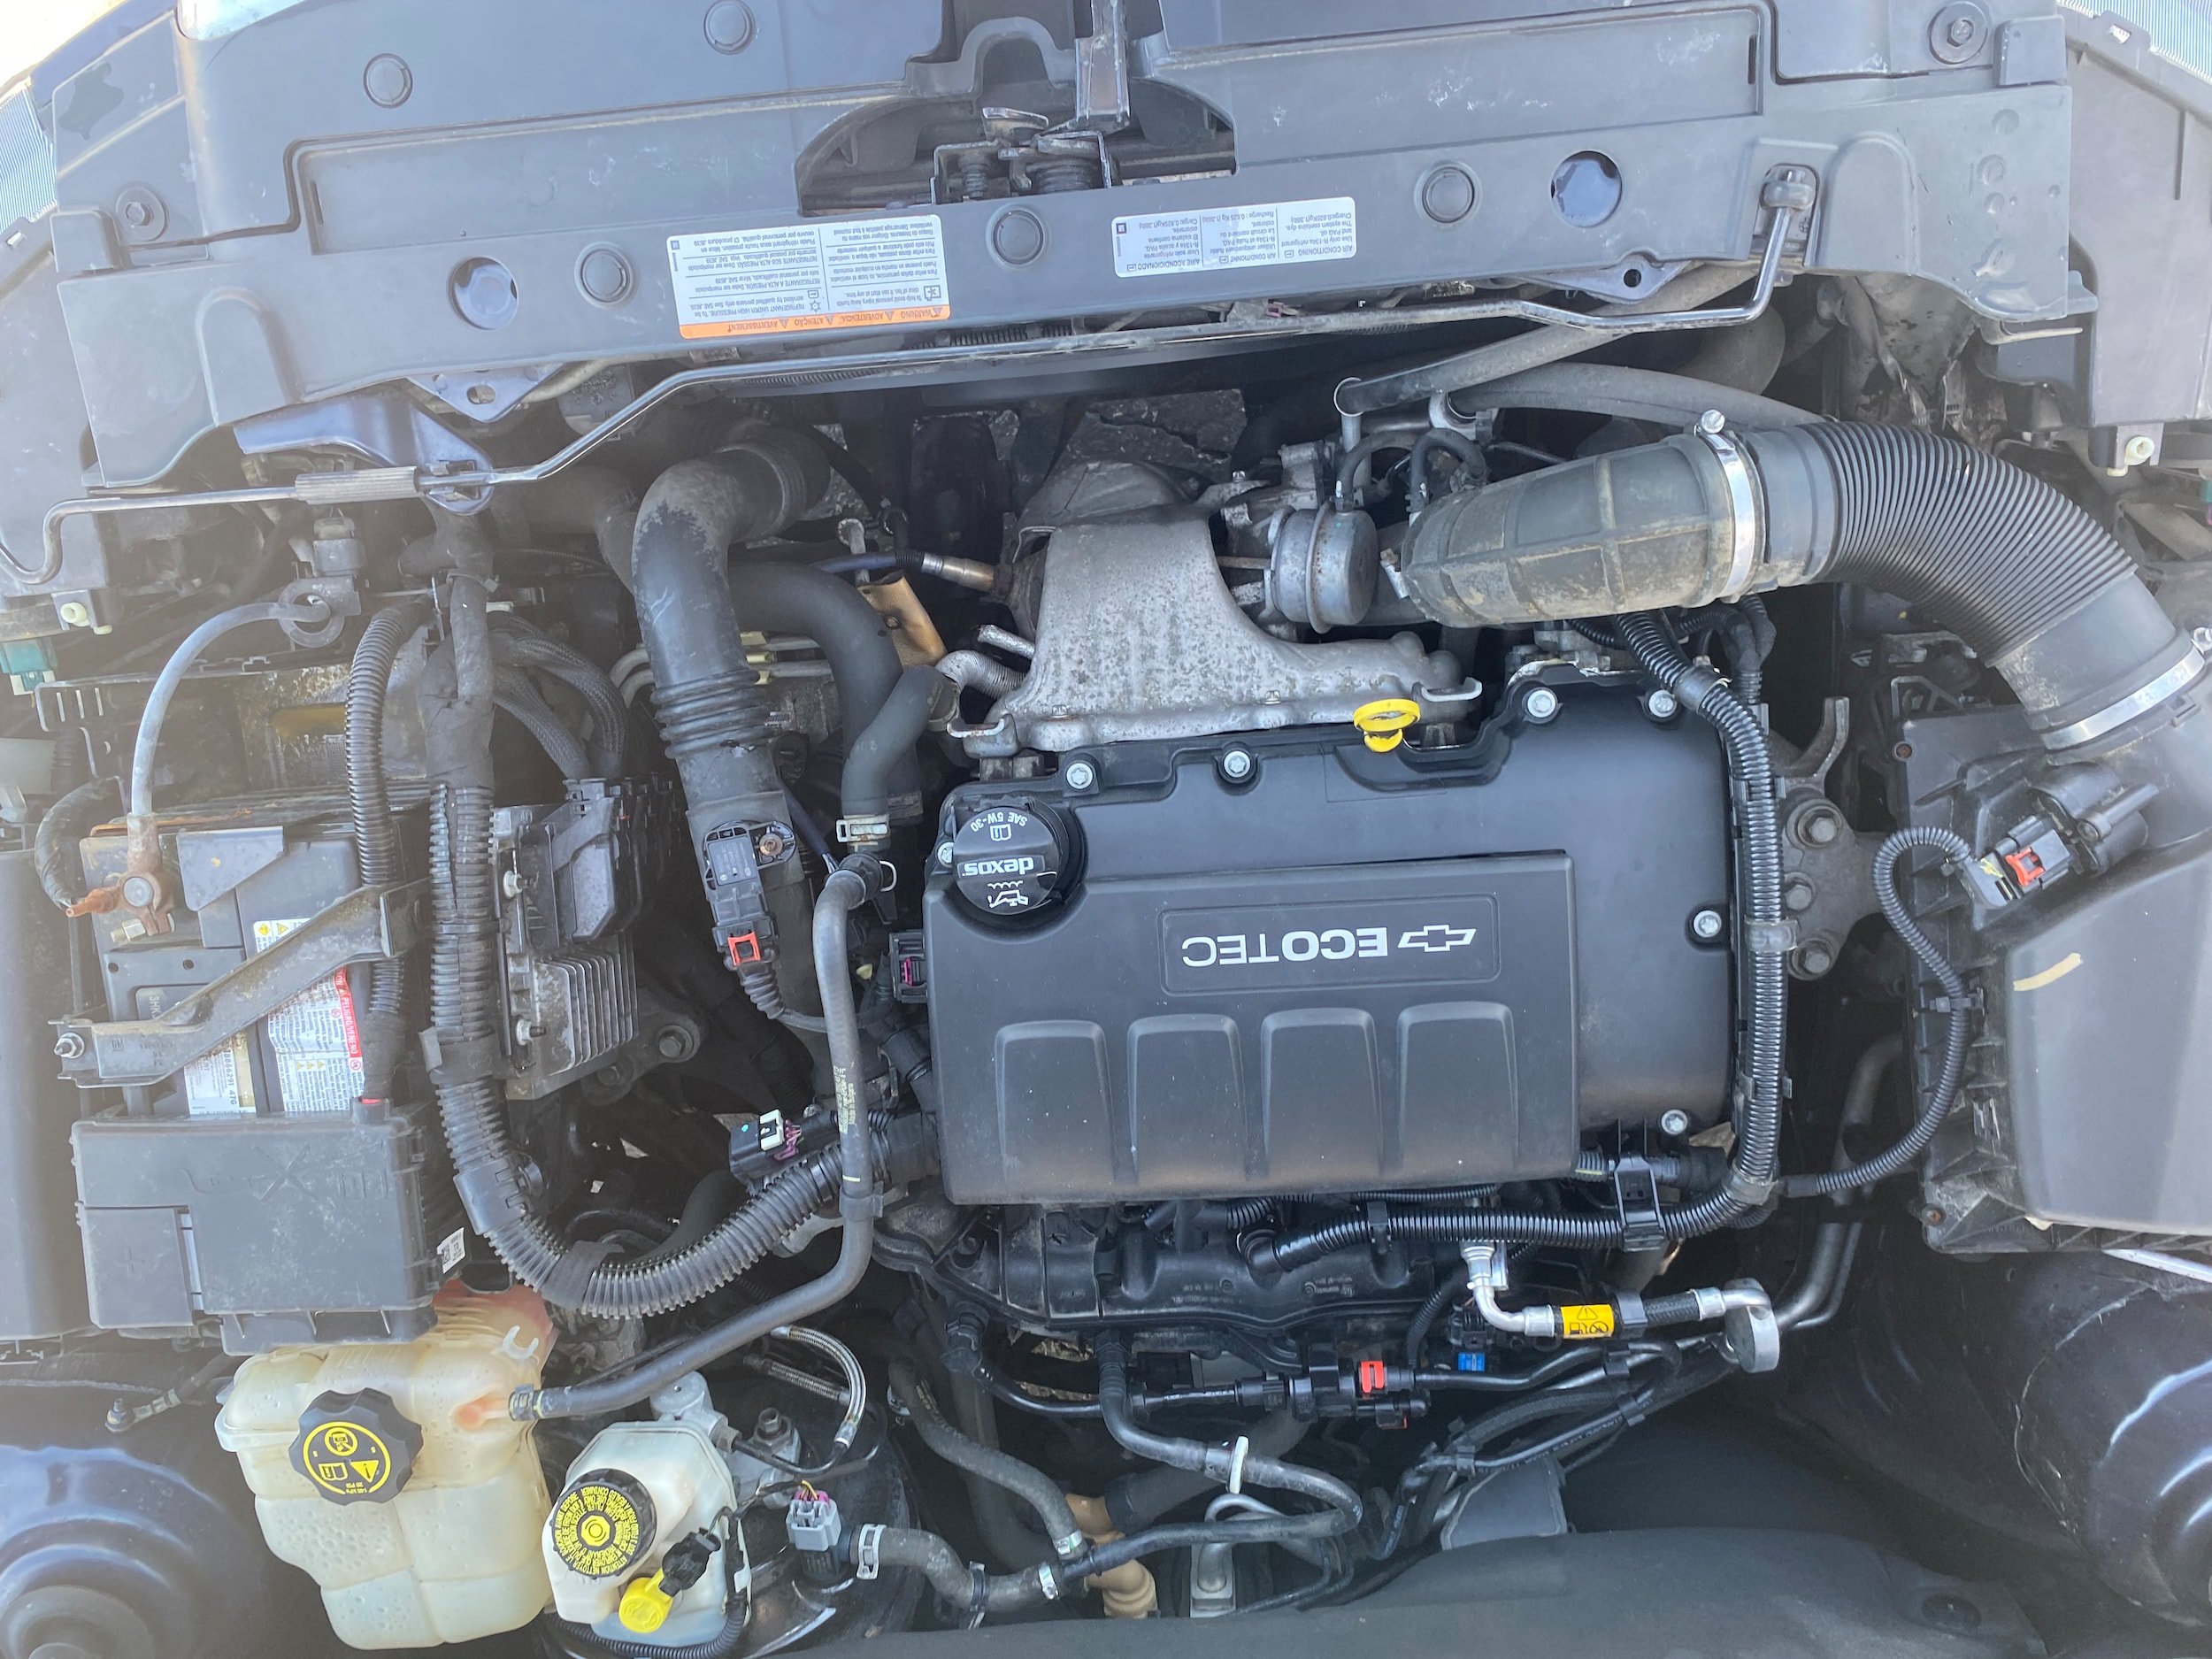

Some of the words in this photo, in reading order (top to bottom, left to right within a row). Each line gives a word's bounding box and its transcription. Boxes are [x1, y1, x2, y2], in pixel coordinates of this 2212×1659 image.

[1248, 210, 1273, 219] Recharge
[1225, 243, 1256, 252] uniquement
[1281, 238, 1308, 247] refrigerant
[1143, 250, 1173, 258] refrigerante
[1298, 245, 1340, 256] CONDITIONING
[1137, 259, 1185, 270] ACONDICIONADO
[770, 302, 804, 311] REFRIGERANT
[900, 308, 931, 319] WARNING
[727, 319, 778, 332] AVERTISSEMENT
[794, 316, 824, 326] ATENÇÃO
[970, 811, 1003, 832] 5W-30
[1008, 811, 1027, 827] SAE
[964, 856, 1033, 875] dexos
[1181, 926, 1388, 968] ECOTEC
[341, 996, 357, 1054] PELIGRO/VENENO
[580, 1486, 609, 1497] CONTAINER
[608, 1488, 629, 1507] SEALED
[582, 1494, 595, 1504] ONLY
[596, 1494, 606, 1503] USE
[569, 1501, 580, 1513] DOT
[585, 1502, 604, 1511] FILLER
[603, 1504, 620, 1521] CLEAN
[562, 1509, 574, 1526] FREIN
[626, 1506, 639, 1523] FROM
[561, 1526, 569, 1535] DE
[630, 1522, 640, 1539] FLUID
[553, 1529, 568, 1557] BOUCHON
[562, 1534, 576, 1555] LIQUIDE
[572, 1540, 582, 1550] UN
[618, 1540, 629, 1552] CAP
[625, 1542, 637, 1556] DOT
[572, 1550, 581, 1561] DU
[586, 1544, 617, 1558] PROVENANT
[564, 1554, 573, 1564] LE
[580, 1555, 591, 1565] QUE
[591, 1552, 618, 1566] EMPLOYER
[601, 1554, 628, 1574] ATTENTION
[571, 1559, 599, 1575] NETTOYER
